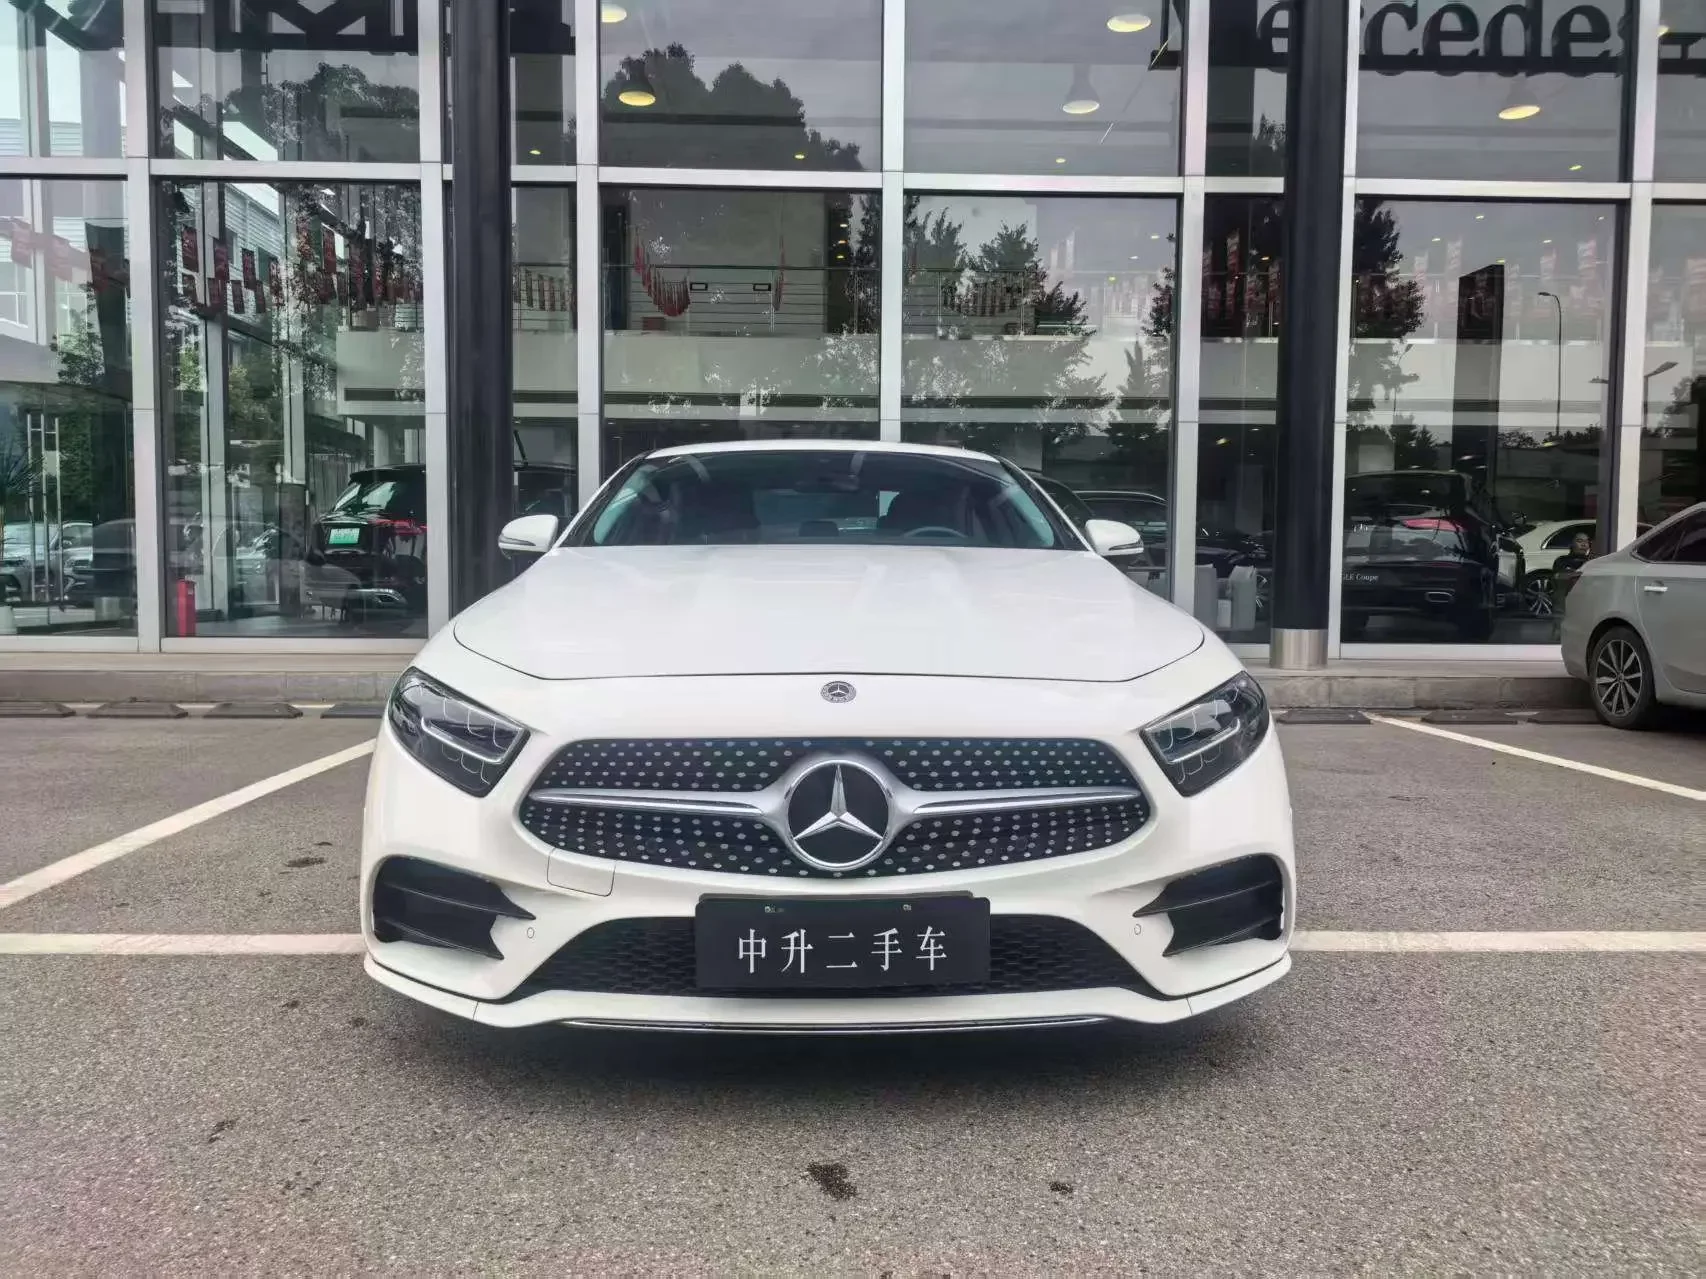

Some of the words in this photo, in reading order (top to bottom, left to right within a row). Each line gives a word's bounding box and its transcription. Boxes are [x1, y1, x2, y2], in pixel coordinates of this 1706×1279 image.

[738, 926, 947, 974] 中升二手车
